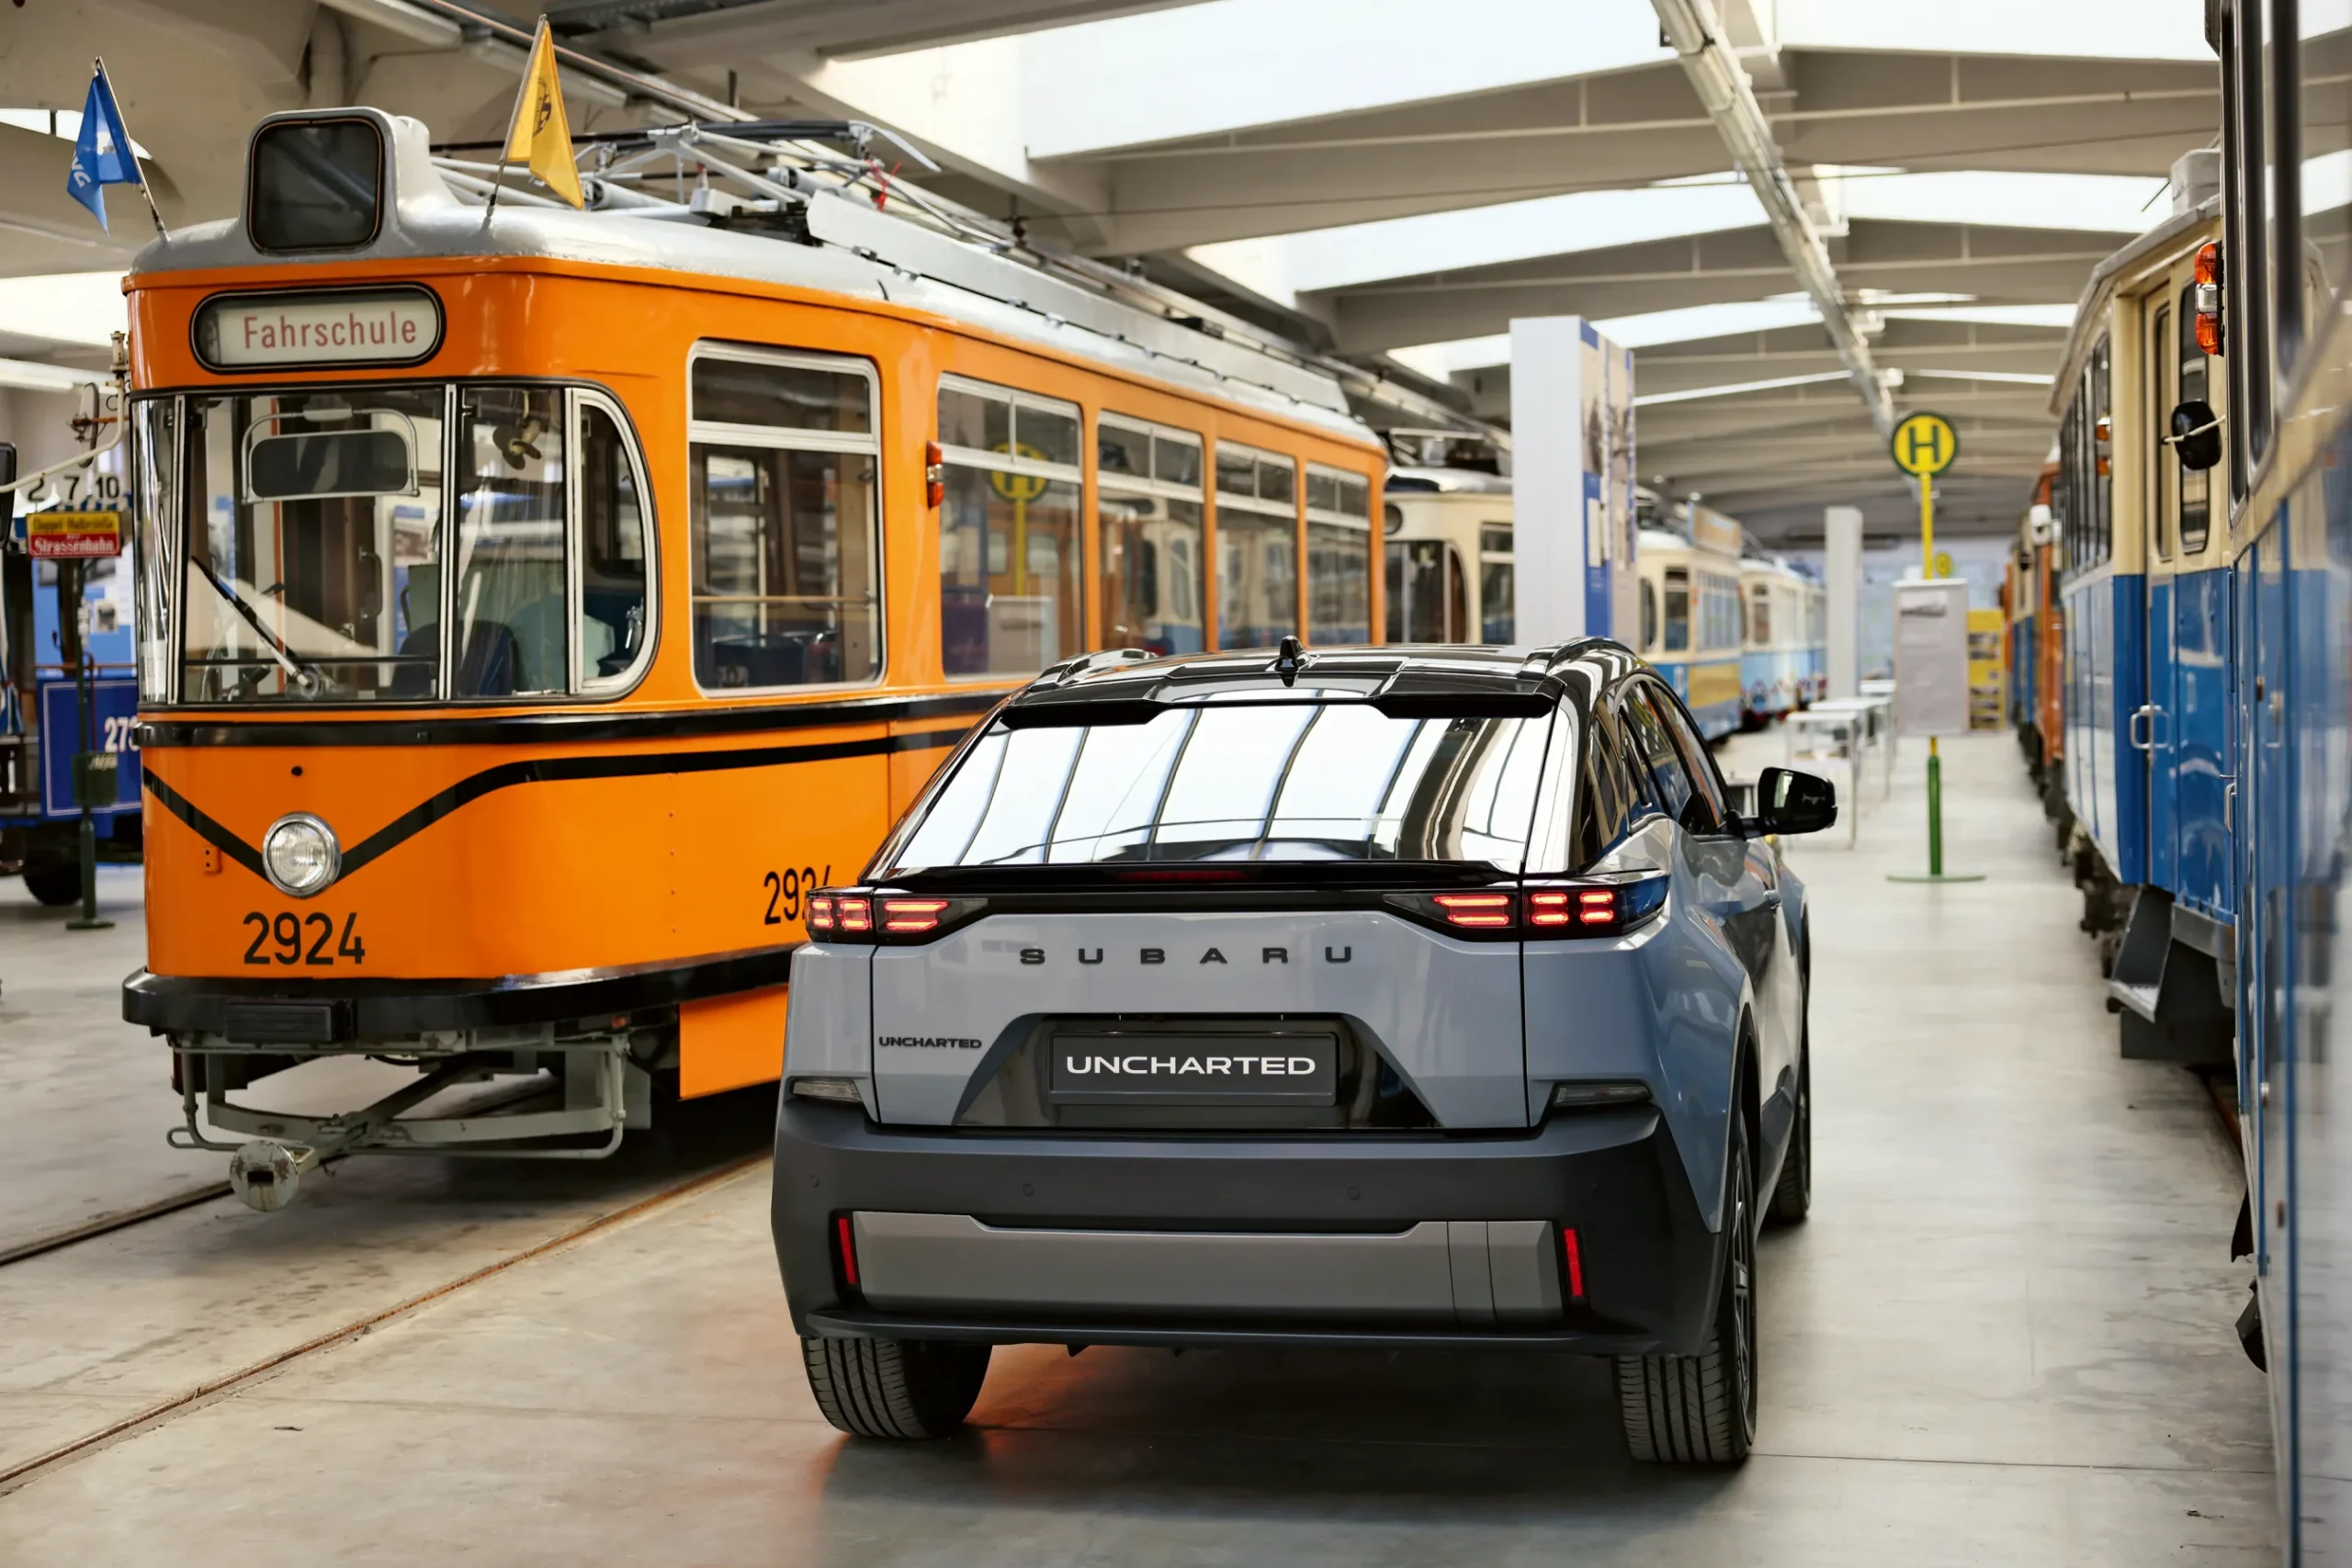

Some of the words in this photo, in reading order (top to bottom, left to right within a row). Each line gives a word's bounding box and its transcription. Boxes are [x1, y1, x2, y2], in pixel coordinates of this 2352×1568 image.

[243, 310, 417, 350] Fahrschule
[1908, 424, 1939, 465] H
[28, 475, 45, 502] 2
[63, 474, 80, 501] 7
[96, 475, 120, 499] 10
[243, 911, 366, 965] 2924
[1019, 946, 1352, 965] SUBARU
[878, 1036, 982, 1049] UNCHARTED
[1066, 1056, 1317, 1076] UNCHARTED
